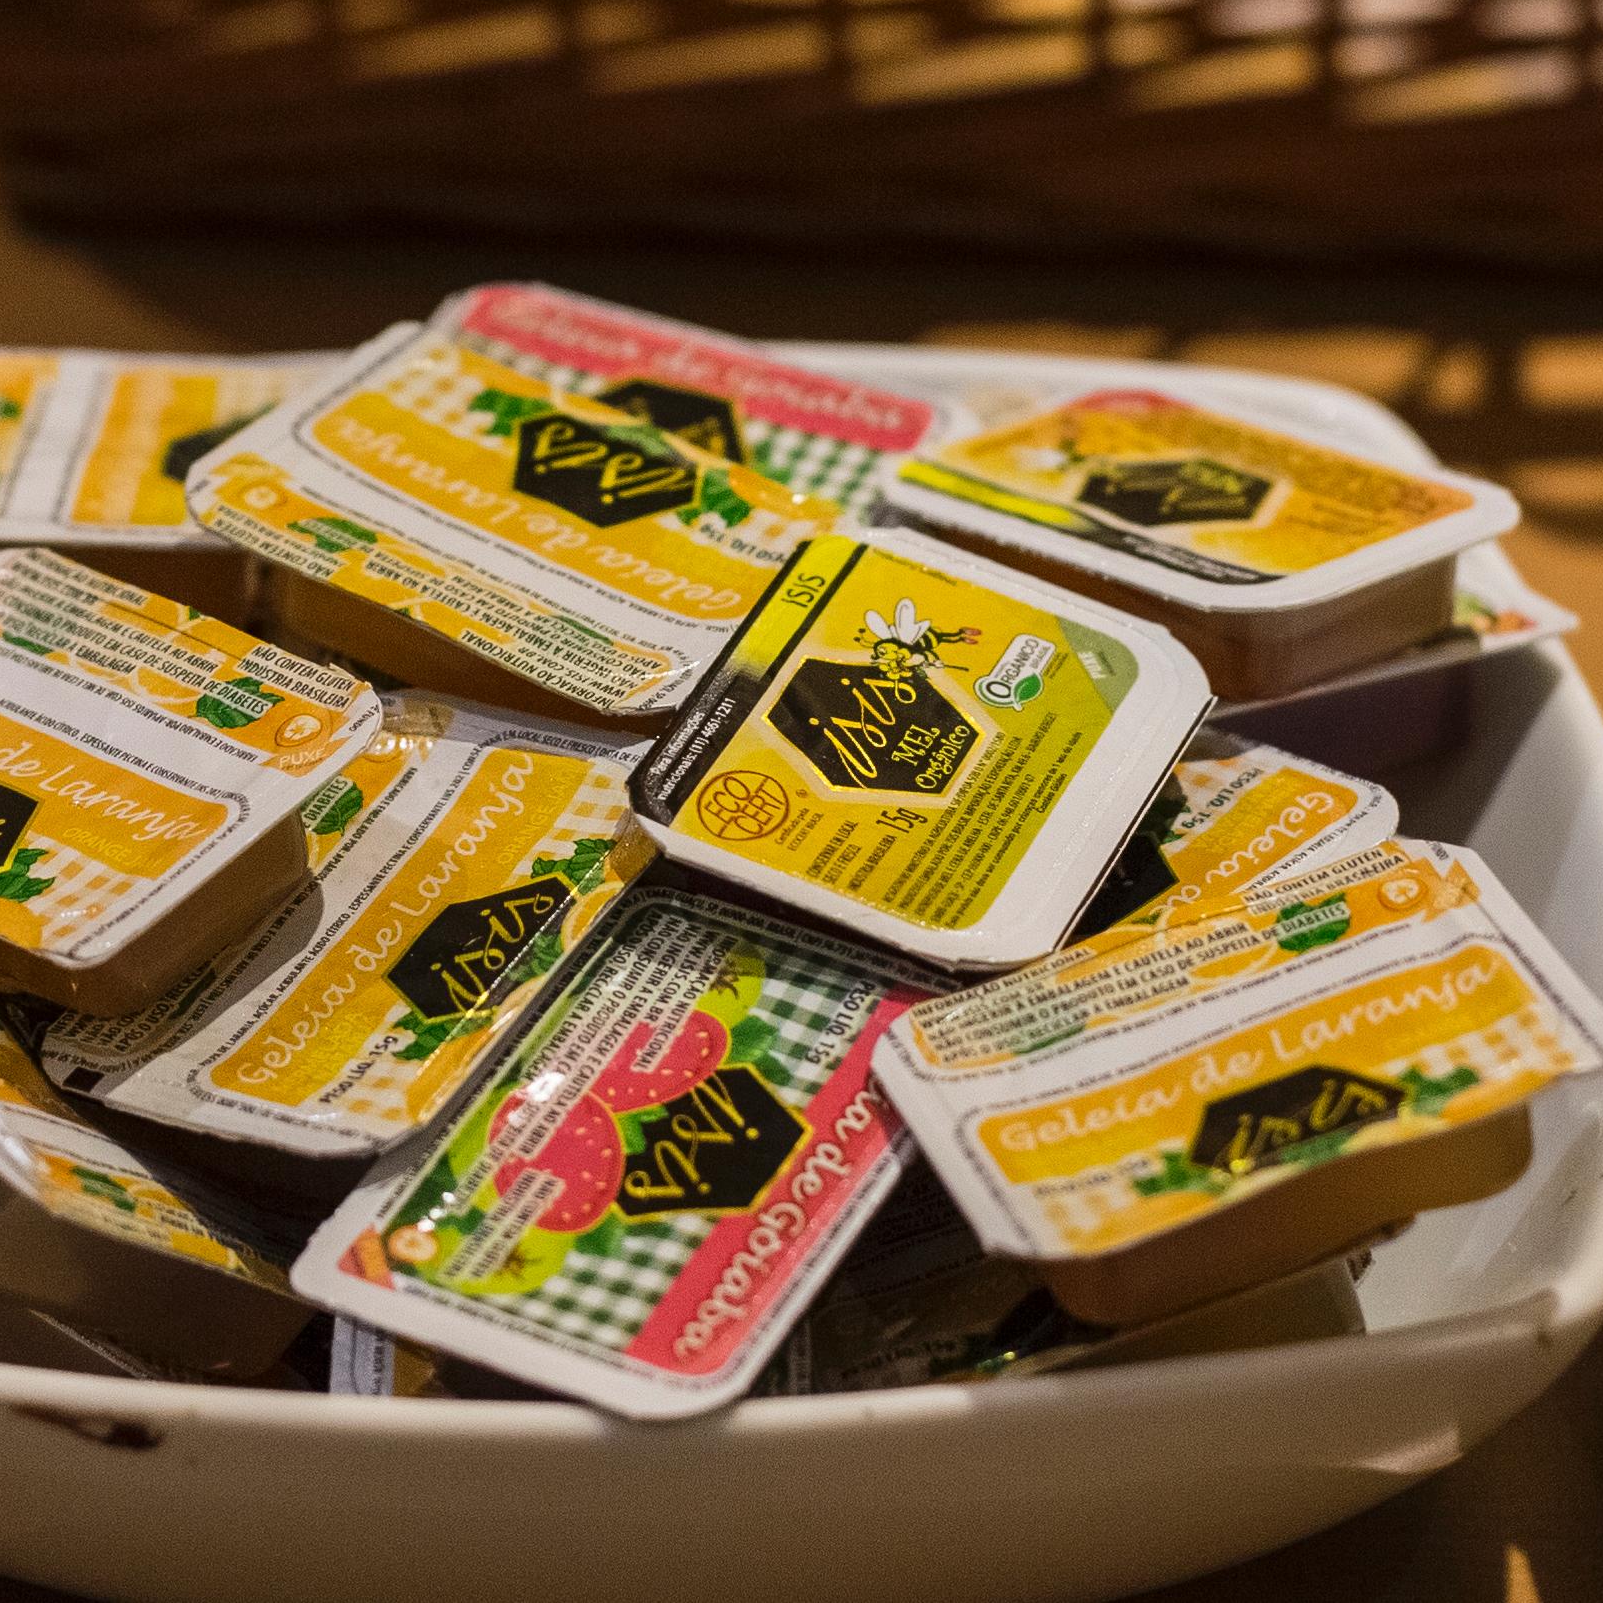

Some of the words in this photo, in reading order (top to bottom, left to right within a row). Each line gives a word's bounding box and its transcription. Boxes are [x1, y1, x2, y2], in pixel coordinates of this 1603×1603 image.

[516, 508, 579, 554] de
[780, 574, 827, 609] ISIS
[454, 629, 542, 673] NUTRICIONAL
[154, 660, 208, 688] SUSPEITA
[213, 685, 270, 715] DIABETES
[235, 657, 297, 688] INDÚSTRIA
[289, 680, 351, 710] BRASILEIRA
[534, 666, 617, 708] INFORMAÇÃO
[809, 676, 917, 787] isis
[891, 724, 939, 769] MEL
[915, 724, 970, 792] Orgânico
[44, 767, 206, 845] Laranja
[298, 776, 352, 820] DIABETES
[702, 775, 753, 825] ECO
[731, 786, 786, 837] CERT
[890, 806, 926, 836] 15g
[1208, 789, 1335, 883] Geleia
[236, 974, 355, 1087] Geleia
[345, 916, 405, 975] de
[397, 755, 536, 912] Laranja
[434, 893, 555, 1019] isis
[613, 936, 670, 990] CONSUMIR
[637, 929, 723, 1022] WWW.ISIS.COM.BR
[641, 942, 688, 986] INGERIR
[678, 935, 741, 999] INFORMAÇÃO
[839, 981, 876, 1012] PESO
[365, 1033, 400, 1060] 15g
[589, 995, 650, 1056] EMBALAGEM
[628, 1000, 695, 1071] NUTRICIONAL
[801, 1038, 838, 1066] 15g
[1000, 1086, 1185, 1152] Geleia
[1189, 1046, 1265, 1095] de
[1267, 955, 1500, 1061] Laranja
[625, 1075, 758, 1200] isis
[786, 1143, 855, 1206] de
[673, 1209, 806, 1355] Goiaba
